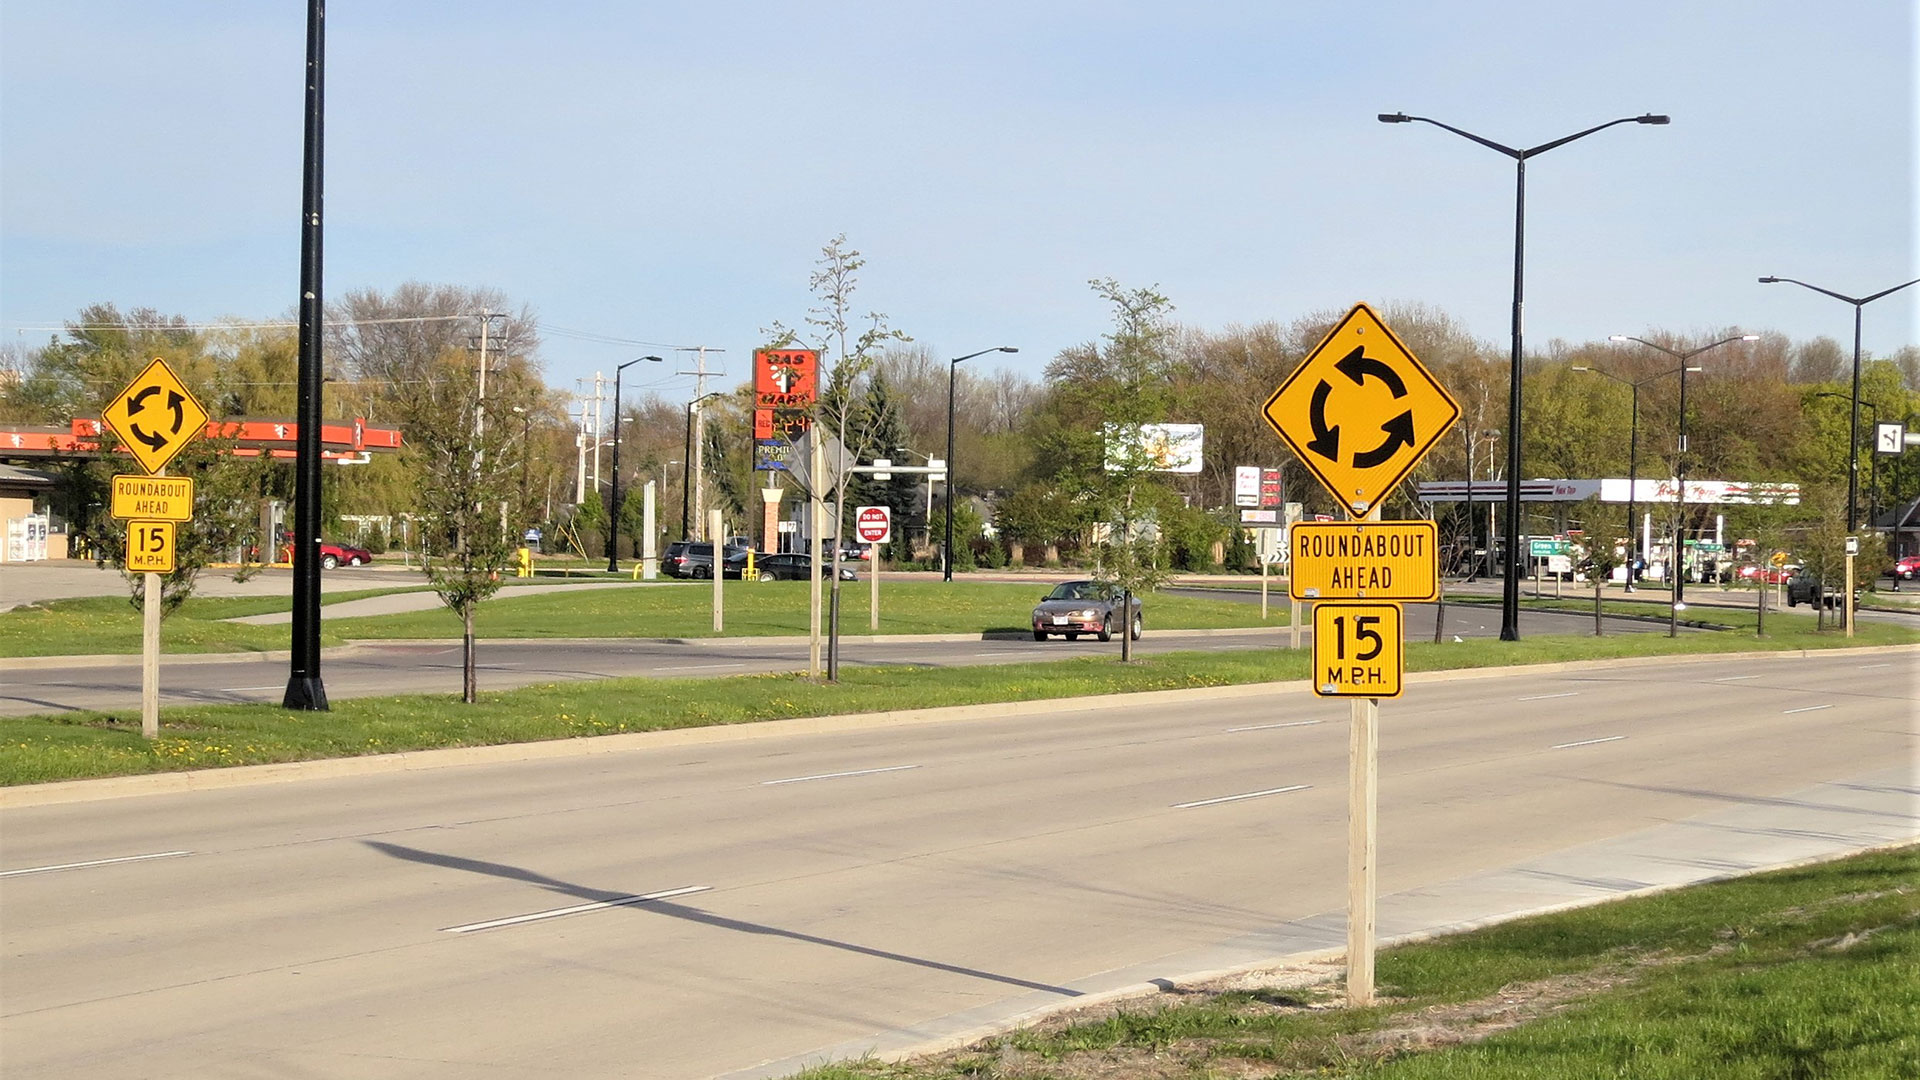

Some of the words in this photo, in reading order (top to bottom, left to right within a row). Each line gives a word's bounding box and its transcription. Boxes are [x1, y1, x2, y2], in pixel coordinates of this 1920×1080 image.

[118, 482, 186, 497] ROUNDABOUT
[135, 500, 168, 514] AHEAD
[139, 528, 165, 552] 15
[864, 529, 882, 537] ENTER
[1301, 535, 1424, 558] ROUNDABOUT
[134, 556, 166, 566] M.P.H.
[1332, 567, 1392, 589] AHEAD
[1334, 616, 1383, 661] 15
[1328, 667, 1386, 685] M.P.H.
